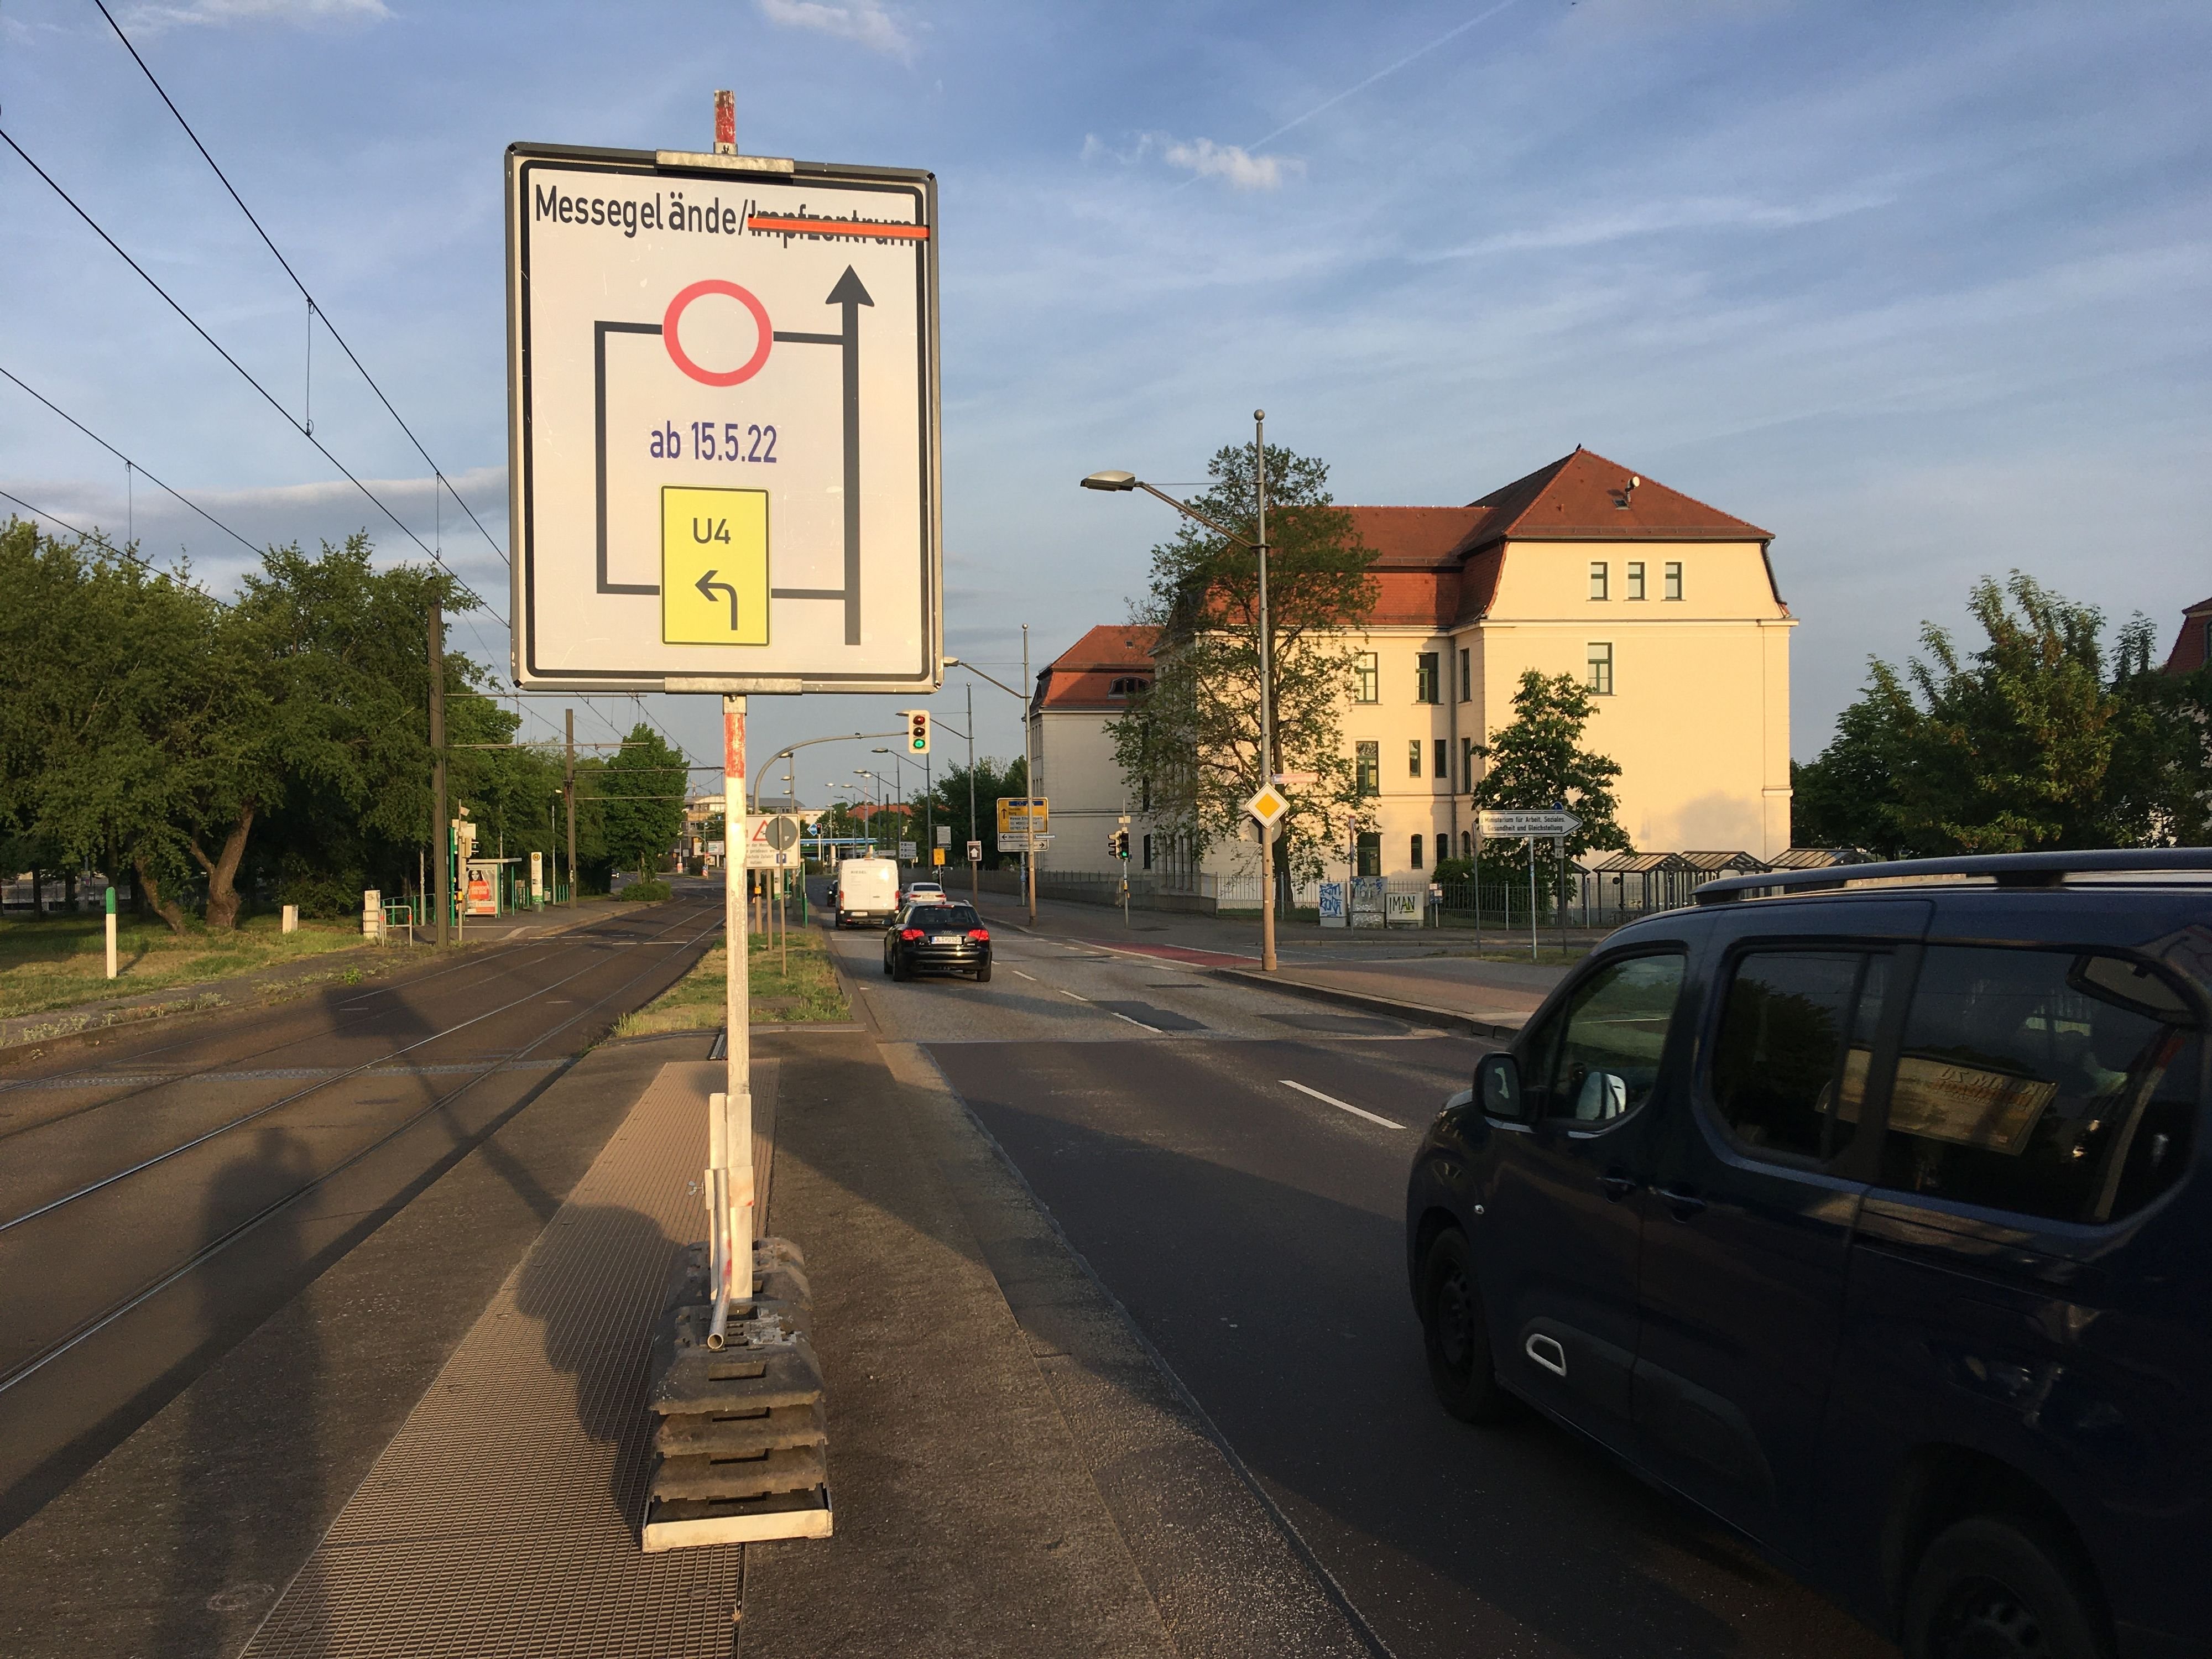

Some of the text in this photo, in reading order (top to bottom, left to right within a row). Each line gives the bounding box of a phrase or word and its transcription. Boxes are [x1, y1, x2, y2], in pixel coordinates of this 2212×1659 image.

[650, 420, 777, 463] ab 15.5.22
[693, 518, 731, 545] U4
[1389, 895, 1415, 914] IMAN
